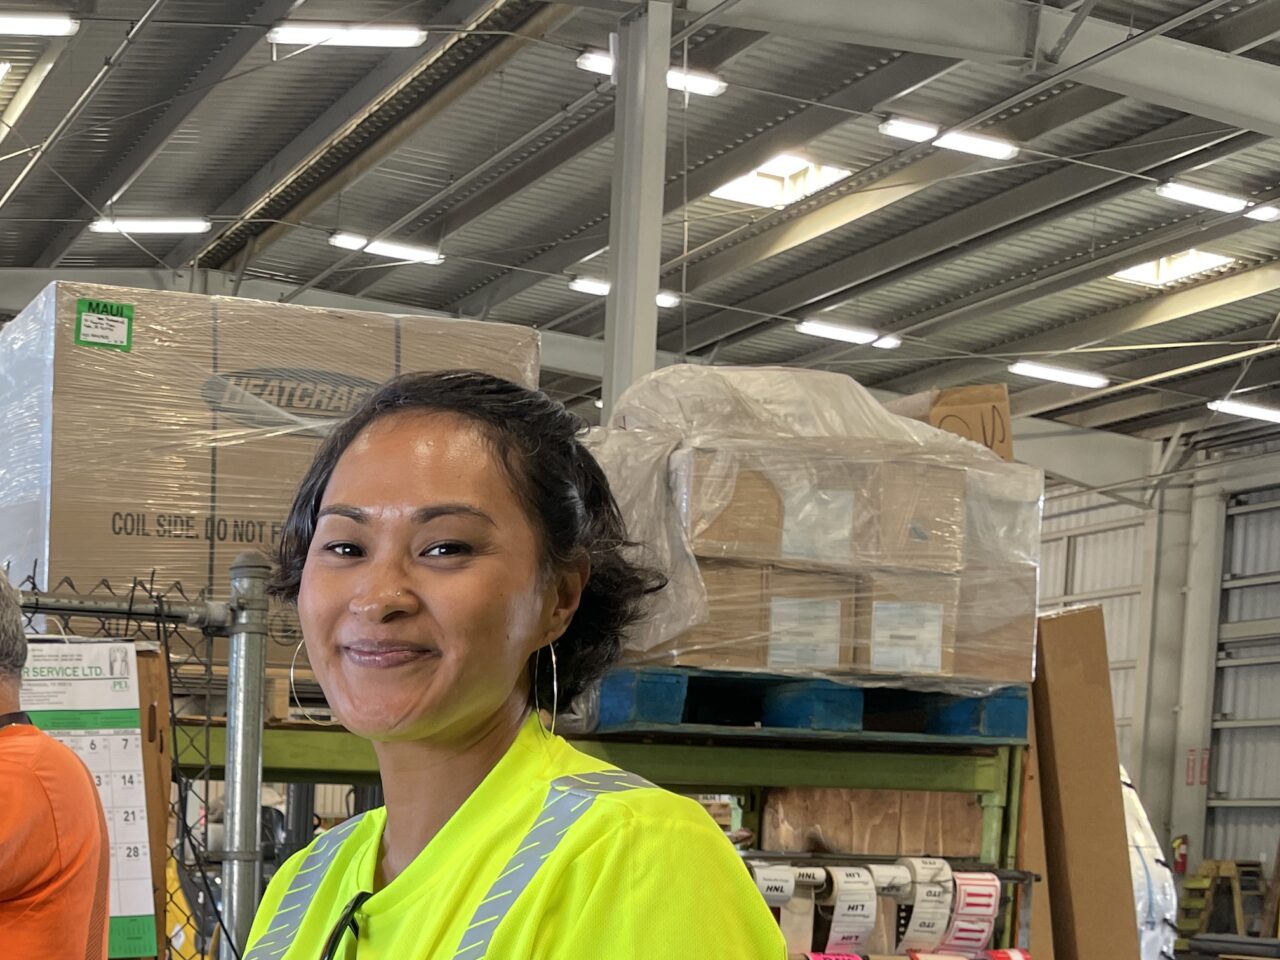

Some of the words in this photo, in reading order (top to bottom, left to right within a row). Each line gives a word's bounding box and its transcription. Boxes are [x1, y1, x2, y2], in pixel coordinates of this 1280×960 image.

[88, 301, 124, 317] MAUI
[222, 377, 369, 412] HEATCRAF
[112, 512, 150, 536] COIL
[156, 514, 199, 539] SIDE.
[205, 517, 227, 541] DO
[233, 520, 267, 543] NOT
[22, 667, 30, 677] R
[32, 666, 79, 677] SERVICE
[82, 666, 104, 676] LTD.
[89, 739, 97, 750] 6
[121, 739, 129, 750] 7
[95, 775, 102, 786] 3
[121, 775, 134, 786] 14
[123, 811, 136, 822] 21
[126, 847, 140, 858] 28
[798, 872, 817, 880] HNL
[766, 885, 785, 893] HNL
